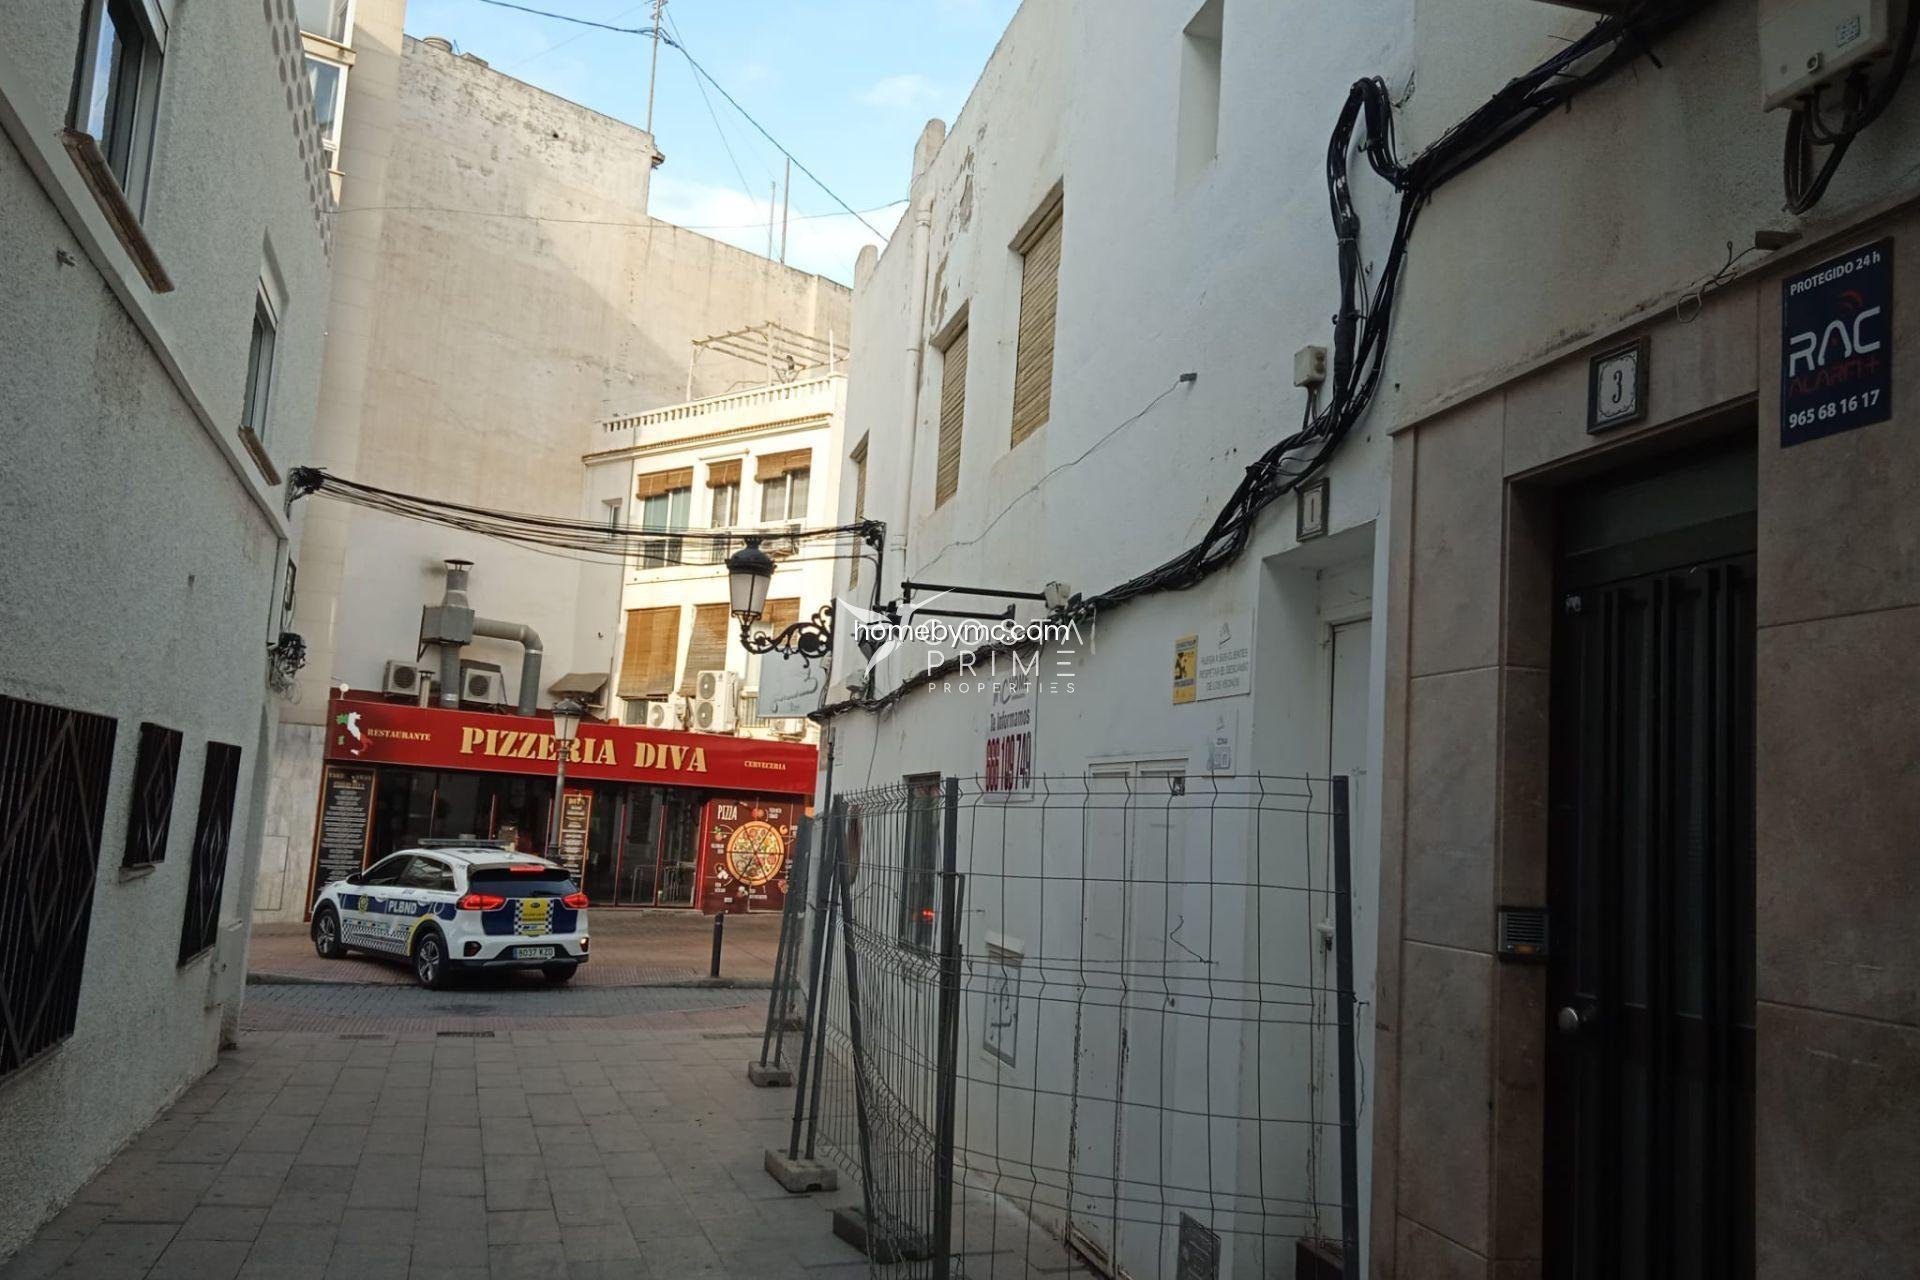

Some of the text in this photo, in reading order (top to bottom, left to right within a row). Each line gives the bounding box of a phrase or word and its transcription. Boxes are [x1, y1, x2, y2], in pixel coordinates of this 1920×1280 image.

[1790, 250, 1881, 296] PROTEGIDO 24 h
[1788, 306, 1881, 377] RAC
[1611, 370, 1623, 404] 3
[1788, 389, 1881, 429] 965 68 16 17
[367, 728, 432, 742] RESTAURANTE
[460, 726, 708, 773] PIZZERIA DIVA
[717, 804, 738, 821] PIZZA
